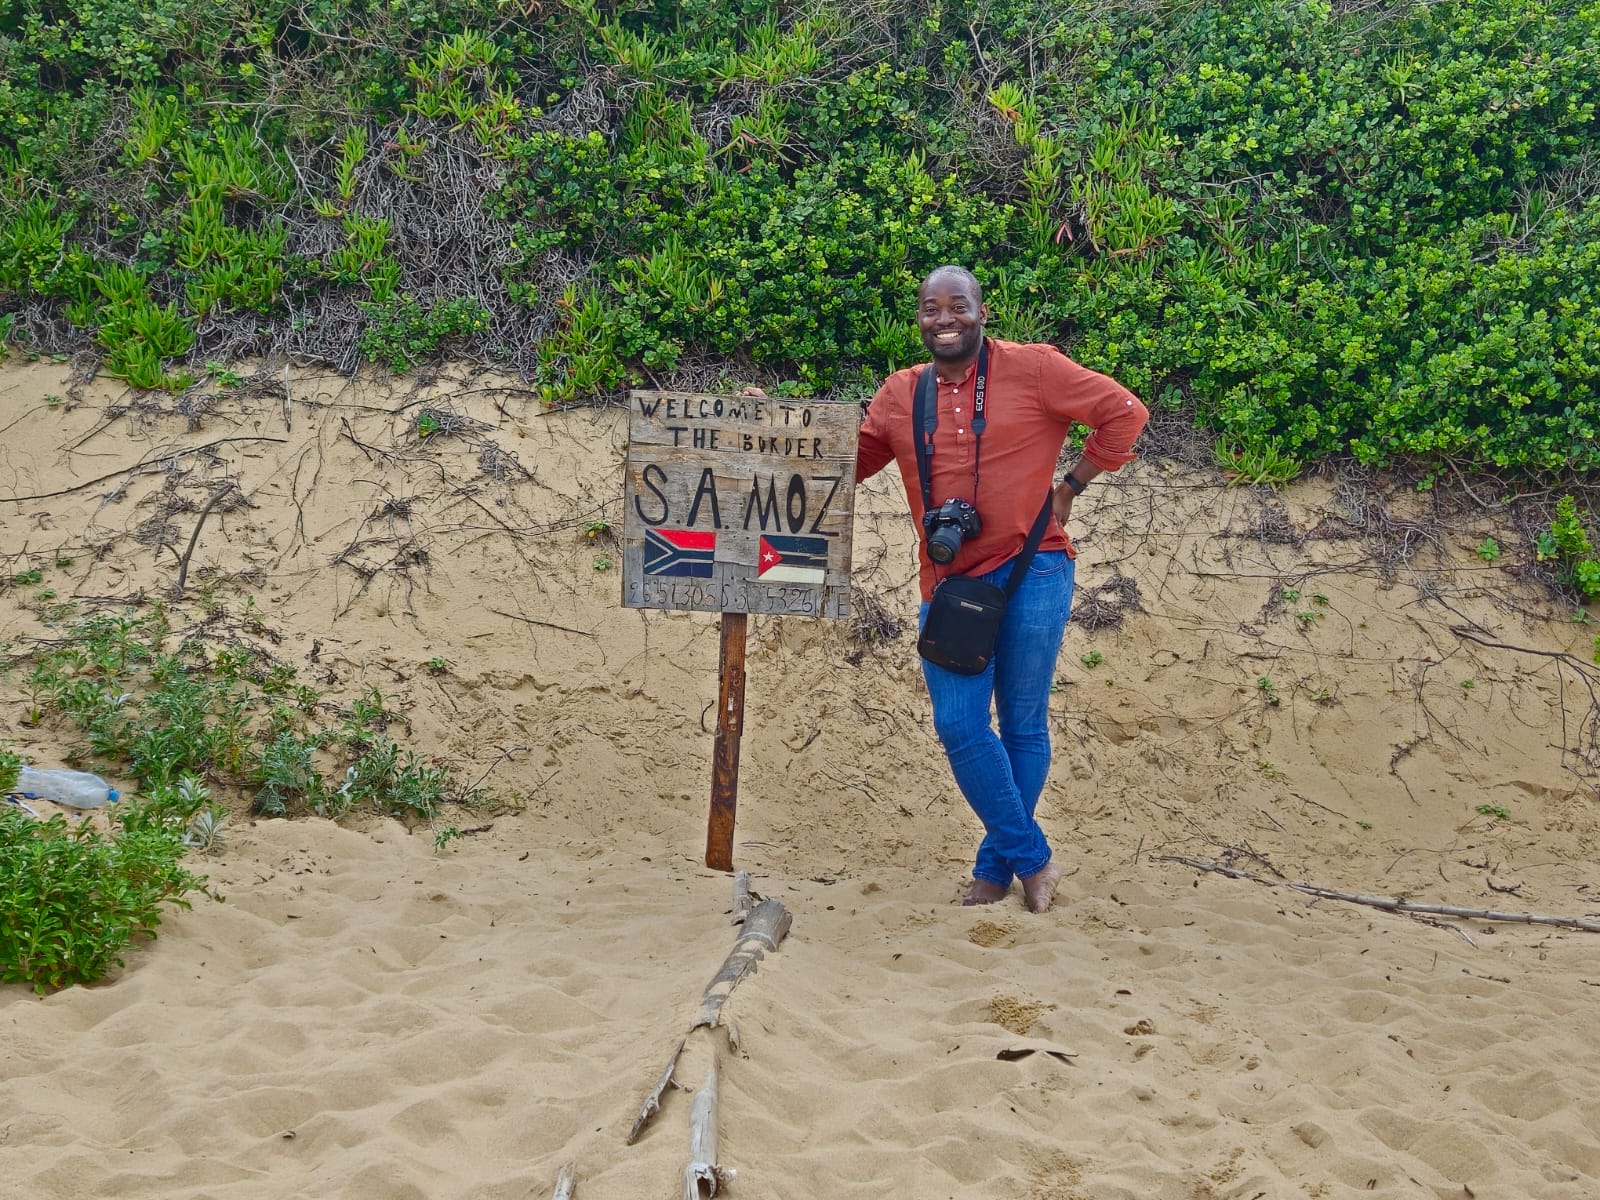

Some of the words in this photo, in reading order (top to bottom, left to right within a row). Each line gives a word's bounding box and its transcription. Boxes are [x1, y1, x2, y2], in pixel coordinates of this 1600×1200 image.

[638, 396, 765, 421] WELCOME
[779, 404, 812, 428] TO
[975, 391, 984, 412] EOS
[667, 426, 721, 450] THE
